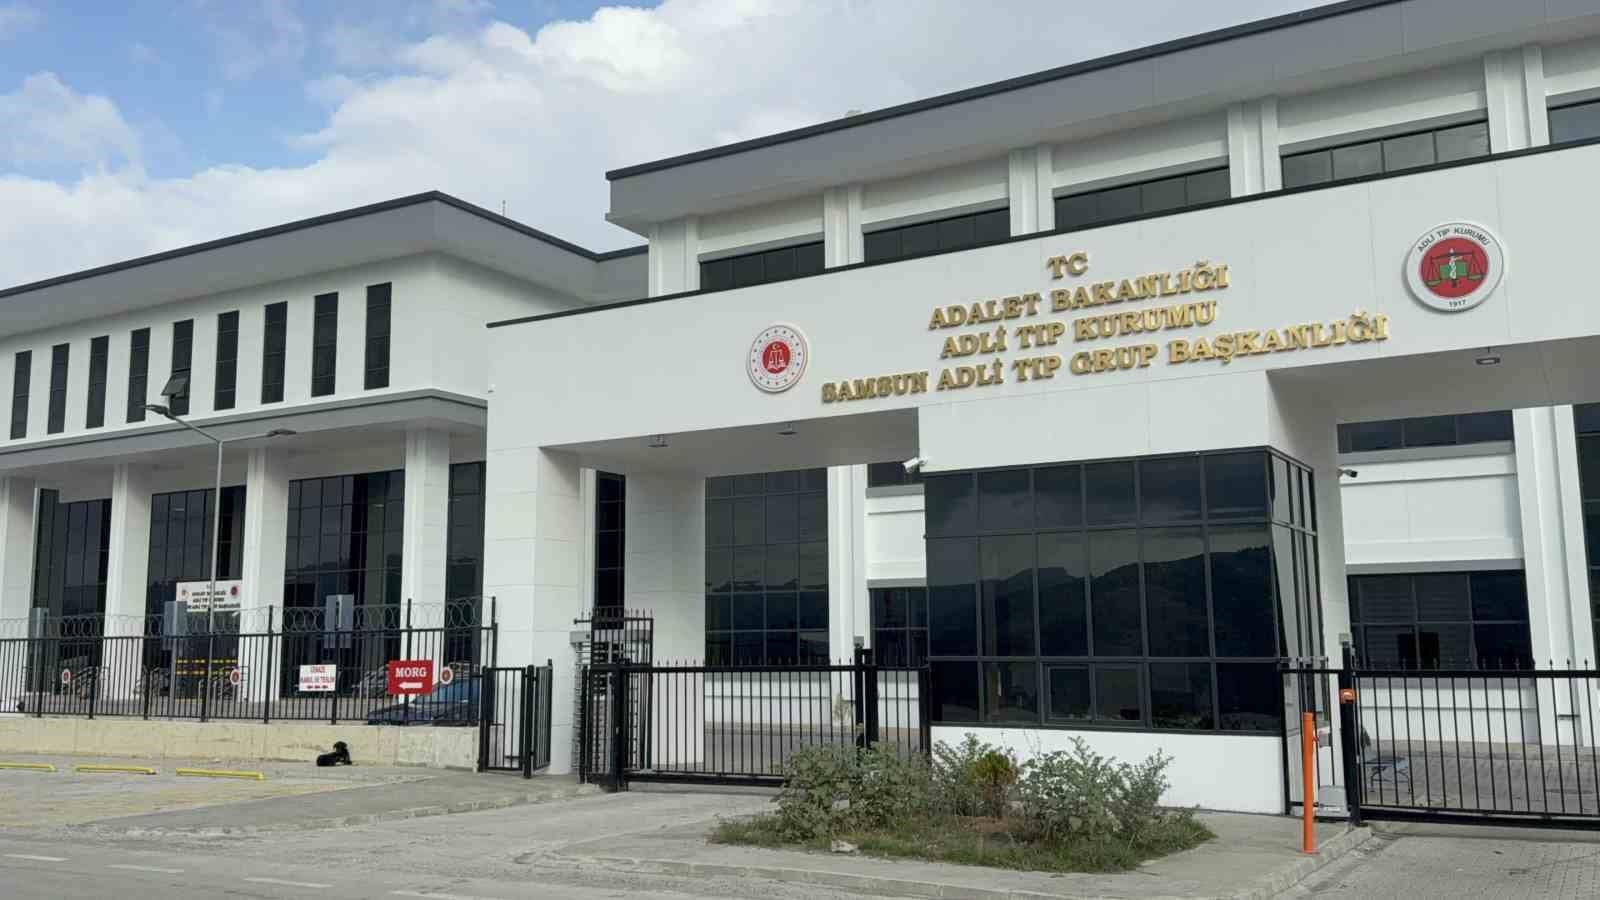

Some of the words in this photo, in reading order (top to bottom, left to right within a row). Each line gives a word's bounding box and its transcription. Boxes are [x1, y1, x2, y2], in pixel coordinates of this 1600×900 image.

[1454, 226, 1491, 246] KURUMU
[1046, 253, 1088, 279] TC
[928, 292, 1042, 331] ADALET
[1050, 260, 1229, 313] BAKANLIĞI
[1448, 299, 1467, 308] 1917
[940, 324, 1007, 359] ADLİ
[1014, 321, 1066, 350] TIP
[1073, 301, 1217, 343] KURUMU
[822, 371, 929, 404] SAMSUN
[937, 357, 1004, 391] ADLİ
[1012, 355, 1062, 383] TIP
[1070, 343, 1158, 375] GRUP
[1167, 310, 1388, 366] BAŞKANLIĞI
[395, 667, 427, 678] MORG
